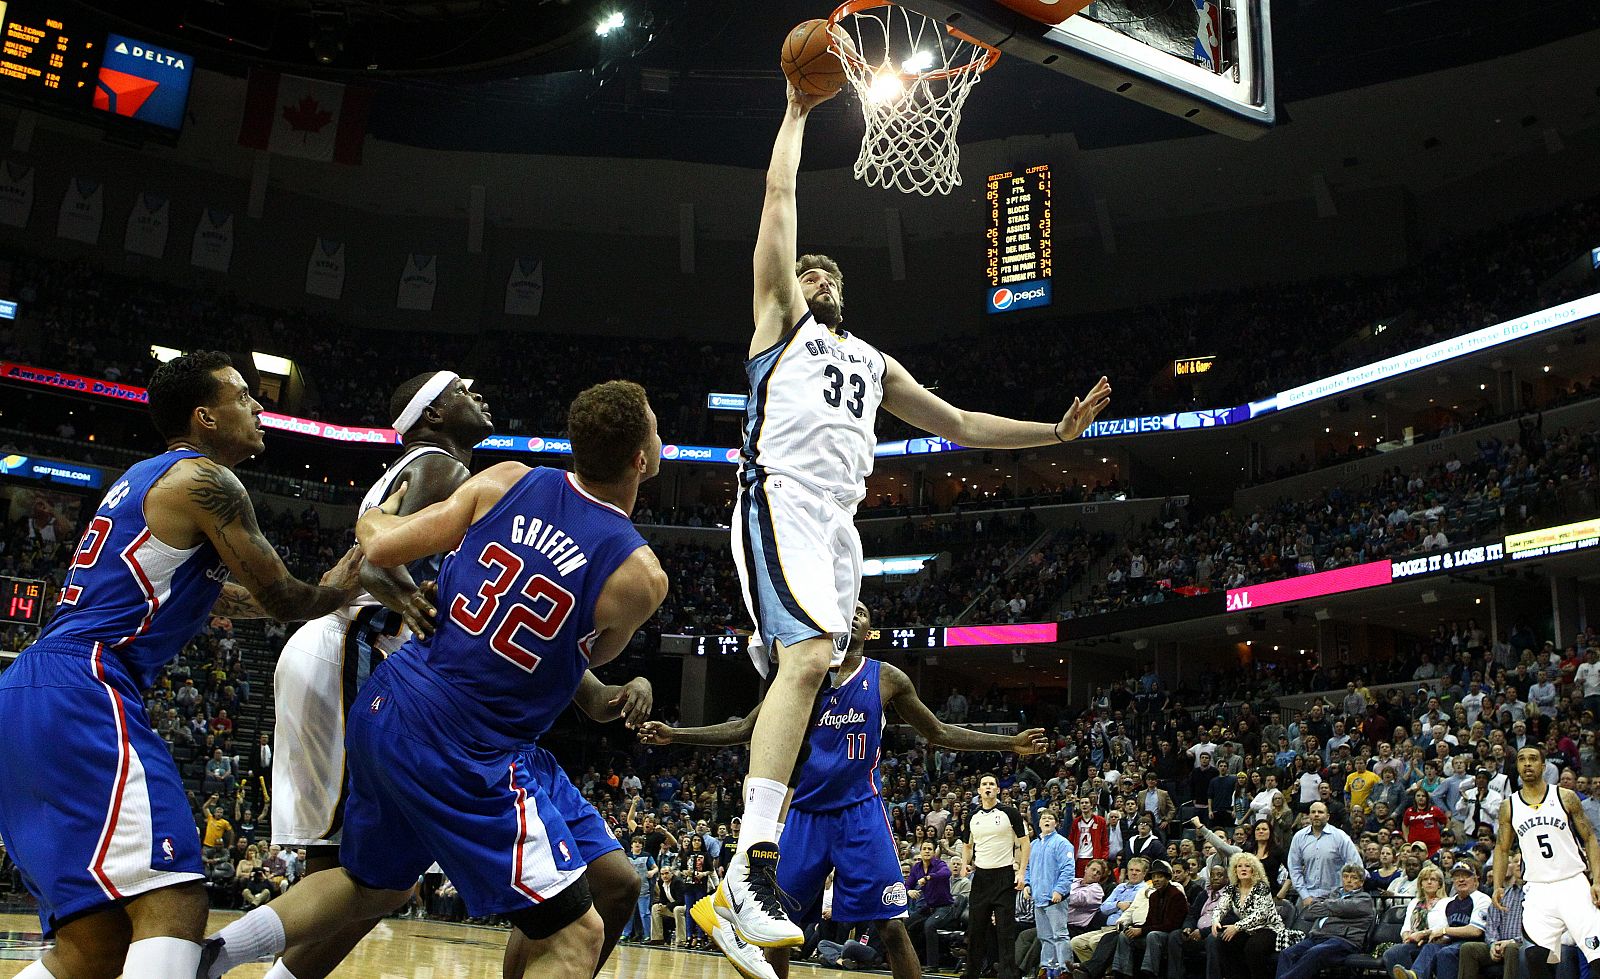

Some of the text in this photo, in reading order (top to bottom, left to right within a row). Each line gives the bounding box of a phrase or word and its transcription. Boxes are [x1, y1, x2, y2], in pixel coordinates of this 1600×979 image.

[8, 22, 46, 38] PELICANS
[46, 19, 63, 30] NBA
[7, 30, 40, 44] BOBCATS
[3, 46, 28, 59] MAGIC
[5, 41, 33, 53] KNICKS
[132, 46, 185, 70] DELTA
[0, 61, 41, 77] MAVERICKS
[987, 181, 999, 190] 48
[1039, 171, 1051, 180] 41
[989, 166, 1049, 181] GRIZZLIES CLIPPERS
[987, 181, 1051, 200] 85 FT% 61
[992, 199, 999, 208] 5
[1011, 196, 1019, 204] PT
[1020, 194, 1031, 202] FGS
[1045, 189, 1051, 198] 7
[992, 200, 1051, 218] 8 BLOCKS 4
[993, 209, 1051, 227] 7 STEALS 6
[986, 219, 1051, 238] 26 ASSISTS 23
[992, 229, 1051, 247] 5 OFF. REB. 12
[987, 239, 1051, 258] 34 DEF. REB. 34
[990, 248, 1051, 267] 12 TURNOVERS 12
[986, 259, 1052, 277] 56 PTS IN PAINT 34
[992, 268, 1052, 286] 2 FASTBREAK PTS 19
[1013, 287, 1045, 303] pepsi
[805, 339, 877, 383] GRZZLIES
[1177, 362, 1189, 375] Golf
[1190, 361, 1195, 374] &
[1289, 391, 1304, 402] Get
[1307, 389, 1313, 397] a
[1316, 379, 1344, 395] quote
[1346, 370, 1374, 384] faster
[1377, 361, 1400, 375] than
[1404, 356, 1422, 368] you
[1425, 349, 1444, 360] can
[1447, 342, 1464, 353] eat
[1468, 331, 1499, 347] those
[1503, 321, 1530, 336] BBQ
[8, 367, 149, 402] America's Drive-I
[823, 364, 866, 419] 33
[258, 413, 321, 435] merica's
[1082, 416, 1162, 438] RIZZLIES
[481, 438, 514, 449] pepsi
[544, 440, 572, 453] peps
[679, 448, 712, 460] pepsi
[511, 514, 588, 578] GRIFFIN
[1391, 542, 1504, 578] BOOZE IT & LOSE IT!
[9, 597, 33, 619] 14
[449, 541, 576, 675] 32
[700, 636, 706, 644] F
[929, 627, 936, 636] F
[697, 645, 705, 655] 5
[927, 636, 936, 647] 5
[817, 707, 866, 730] Angeles
[846, 733, 867, 760] 11
[1517, 816, 1567, 838] GRIZZLIES
[752, 849, 779, 860] MARC
[1536, 833, 1554, 859] 5
